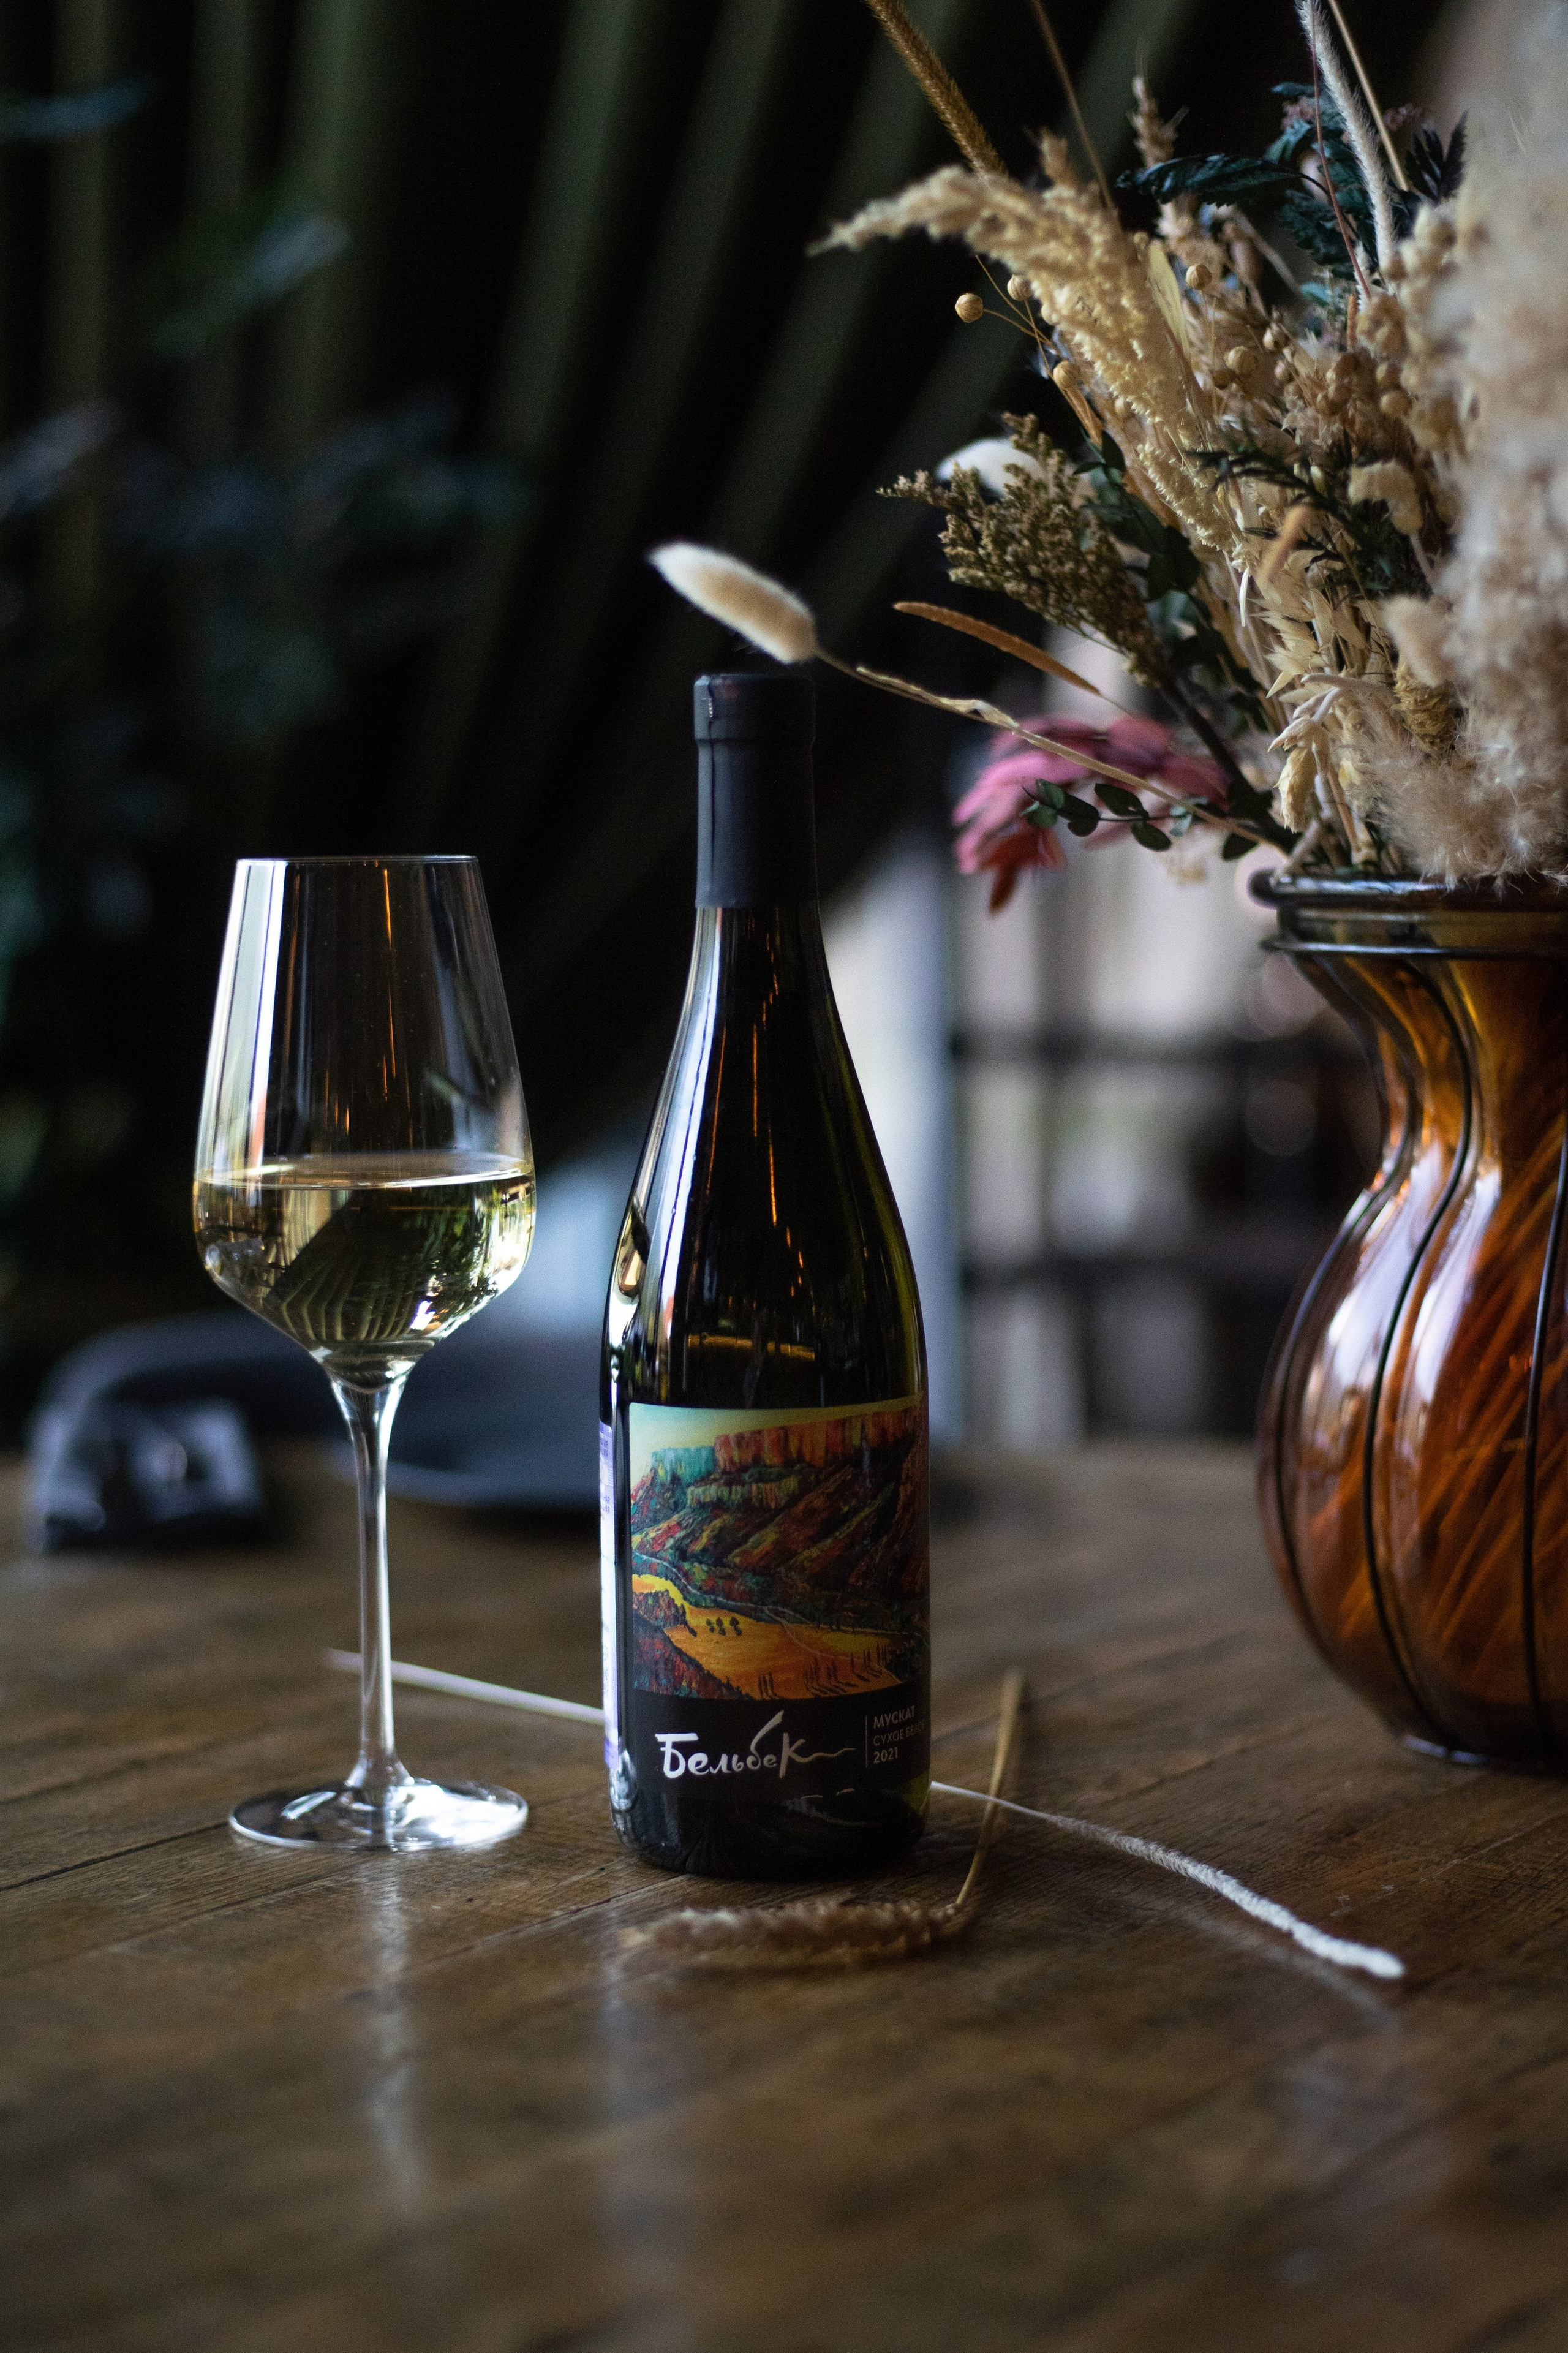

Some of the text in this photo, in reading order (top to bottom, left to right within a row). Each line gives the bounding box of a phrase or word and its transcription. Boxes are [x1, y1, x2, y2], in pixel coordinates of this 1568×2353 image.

[873, 1705, 915, 1729] МУСКАТ
[873, 1729, 904, 1746] СУХОЕ
[873, 1746, 898, 1764] 2021
